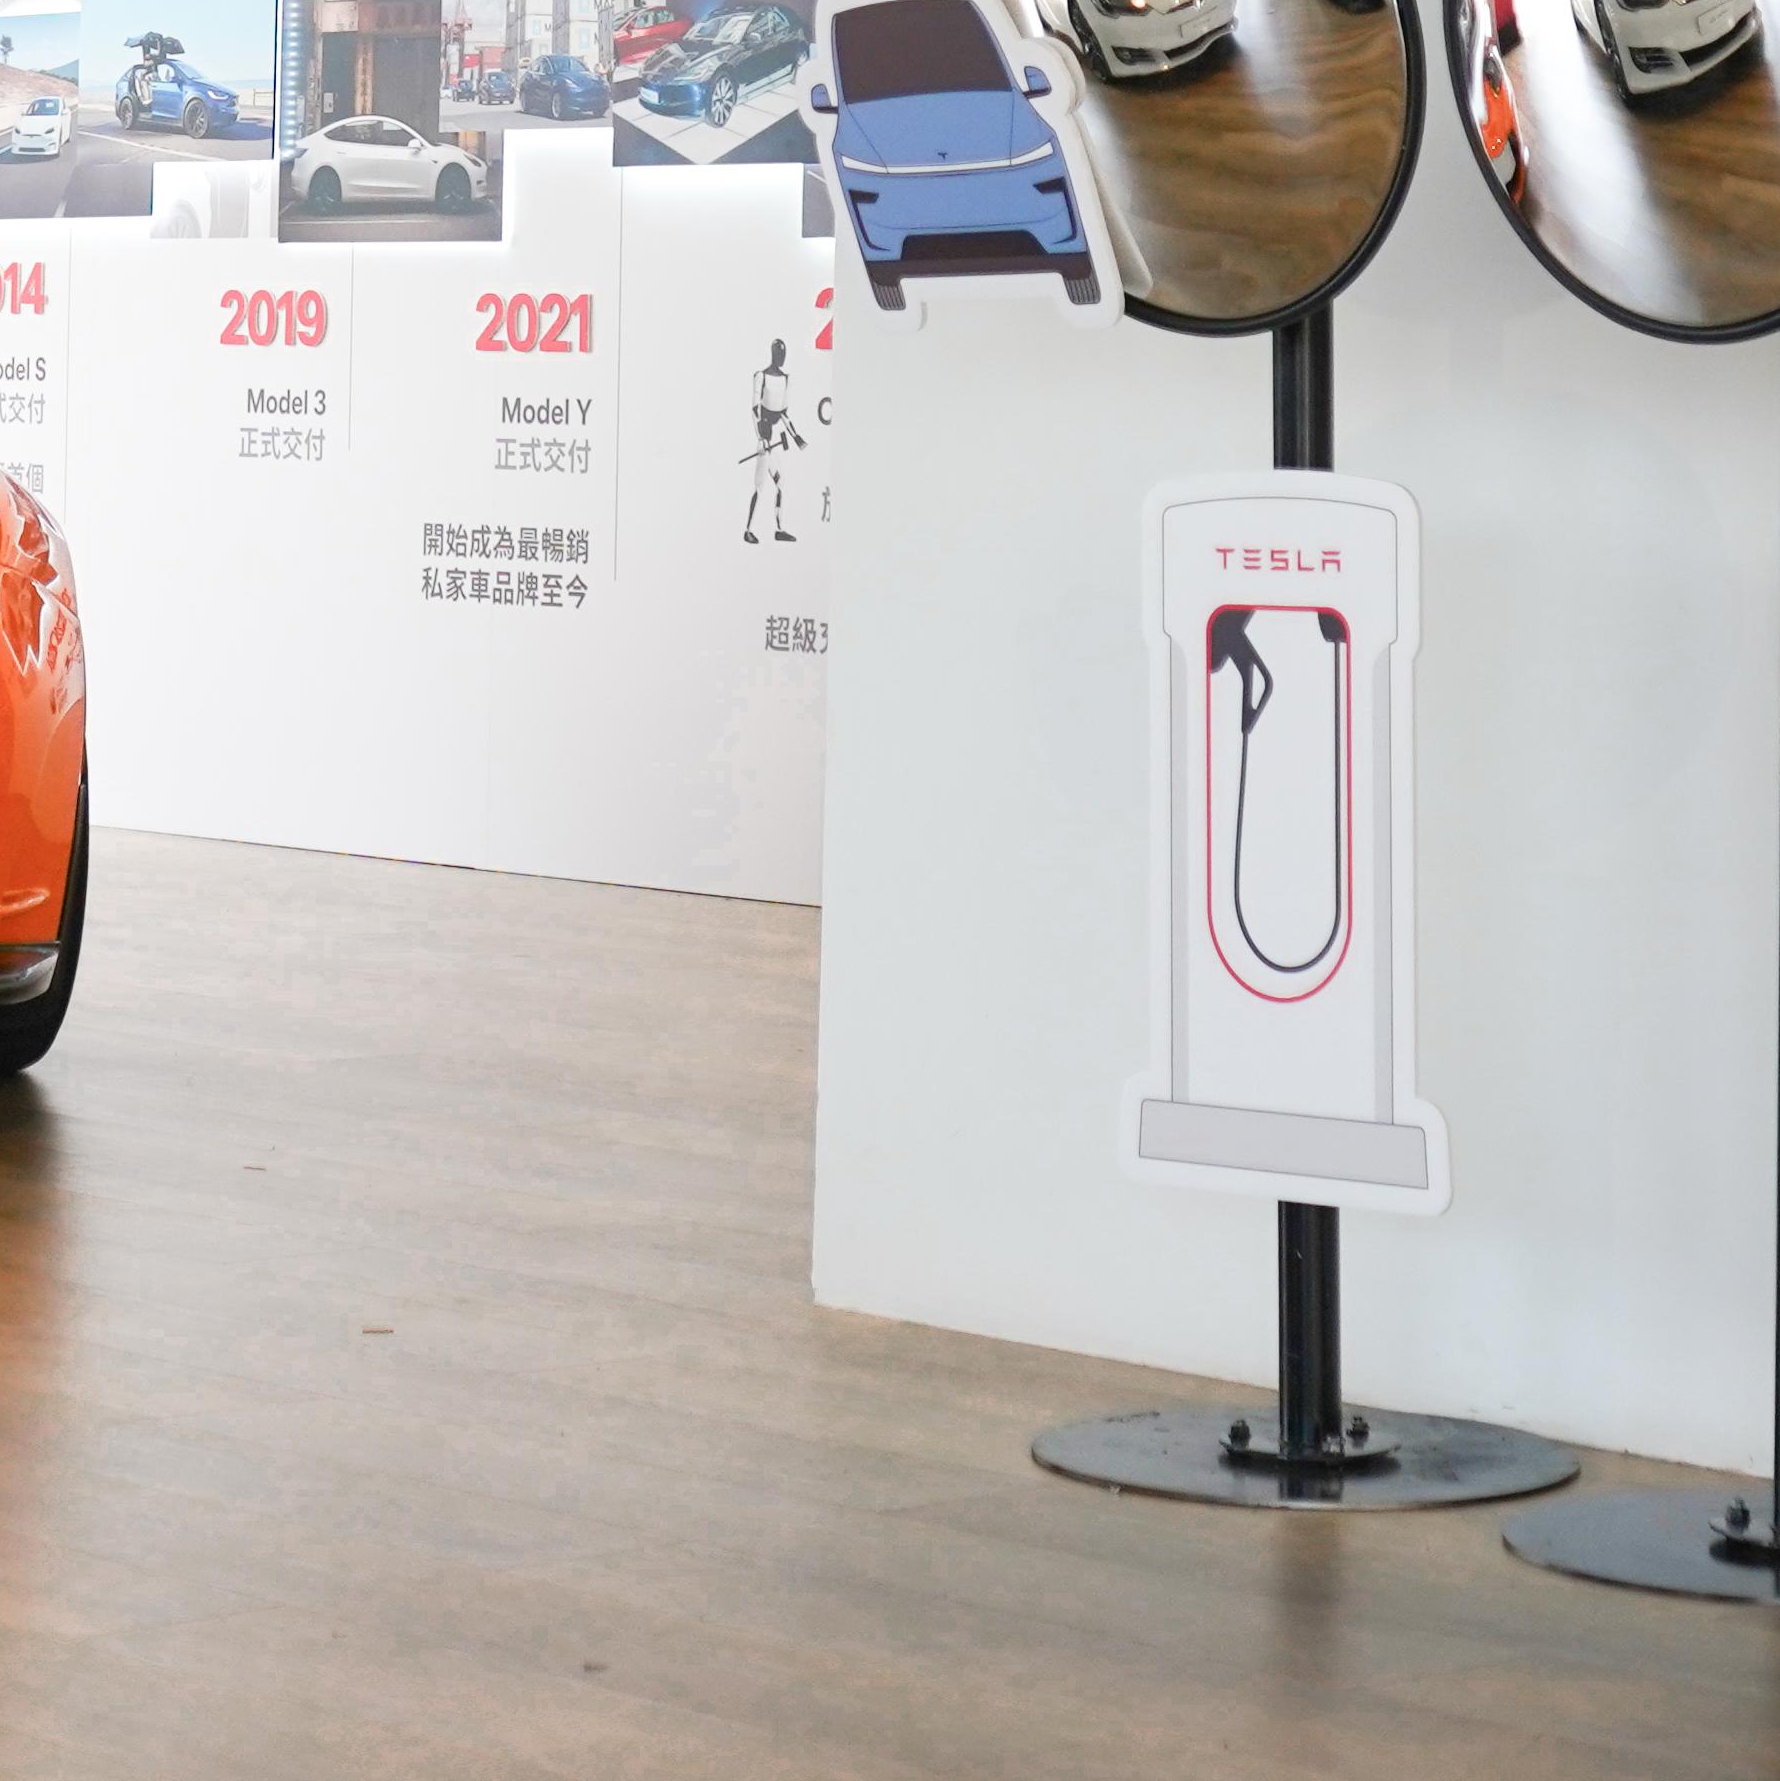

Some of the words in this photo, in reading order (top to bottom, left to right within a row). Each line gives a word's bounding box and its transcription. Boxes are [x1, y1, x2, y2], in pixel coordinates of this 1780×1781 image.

[219, 289, 328, 348] 2019
[475, 292, 593, 353] 2021
[35, 357, 47, 381] S
[247, 388, 309, 415] Model
[313, 389, 327, 415] 3
[501, 396, 570, 426] Model
[576, 398, 593, 426] Y
[238, 426, 326, 462] 正式交付
[494, 436, 592, 475] 正式交付
[422, 522, 590, 564] 開始成為最暢銷
[1215, 548, 1341, 572] TESLA
[421, 567, 589, 610] 私家車品牌至今
[764, 614, 829, 654] 超級
